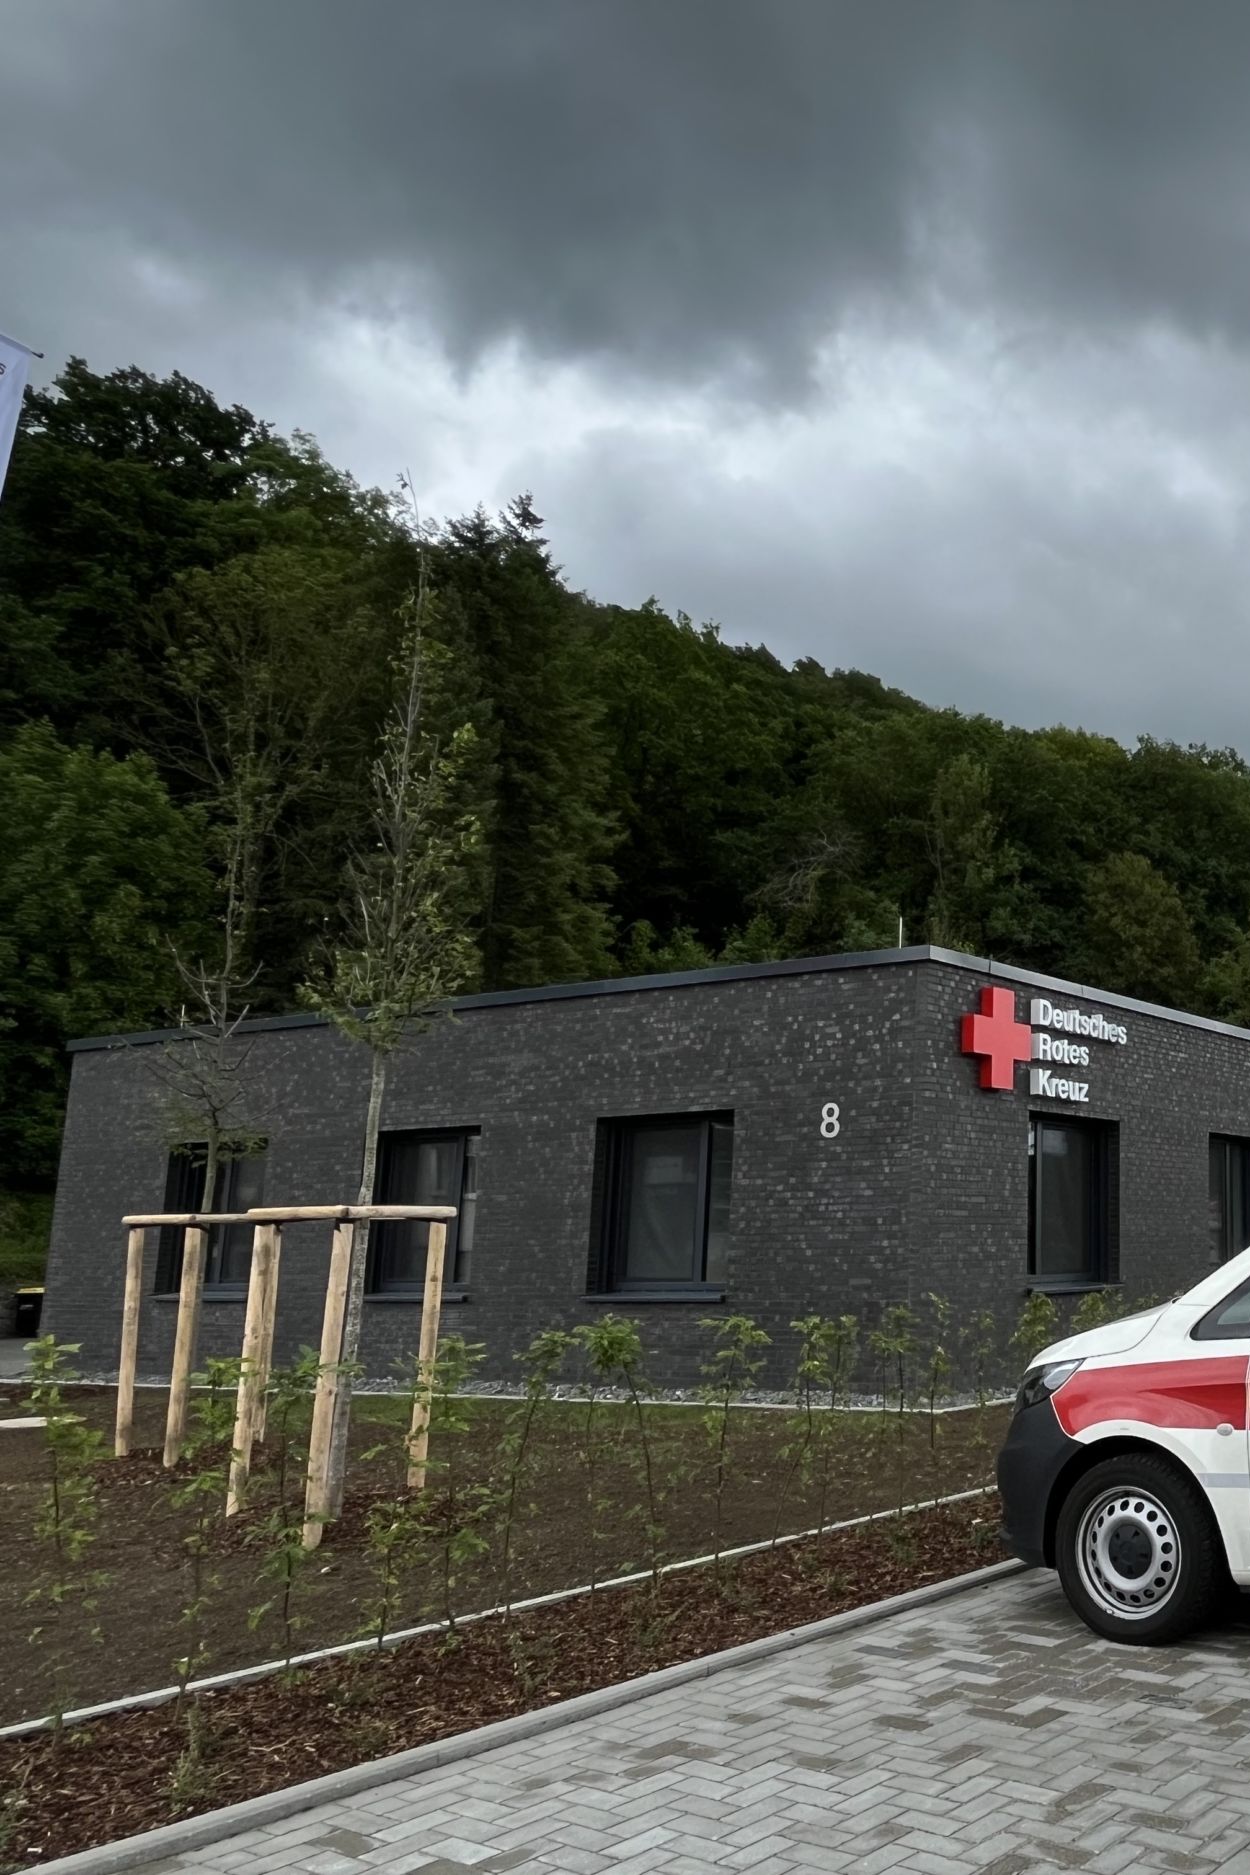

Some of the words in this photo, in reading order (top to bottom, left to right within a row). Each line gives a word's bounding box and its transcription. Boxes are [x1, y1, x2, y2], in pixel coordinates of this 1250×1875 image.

[1031, 998, 1128, 1045] Deutsches
[1031, 1033, 1090, 1067] Rotes
[1030, 1068, 1090, 1103] Kreuz
[820, 1102, 840, 1138] 8
